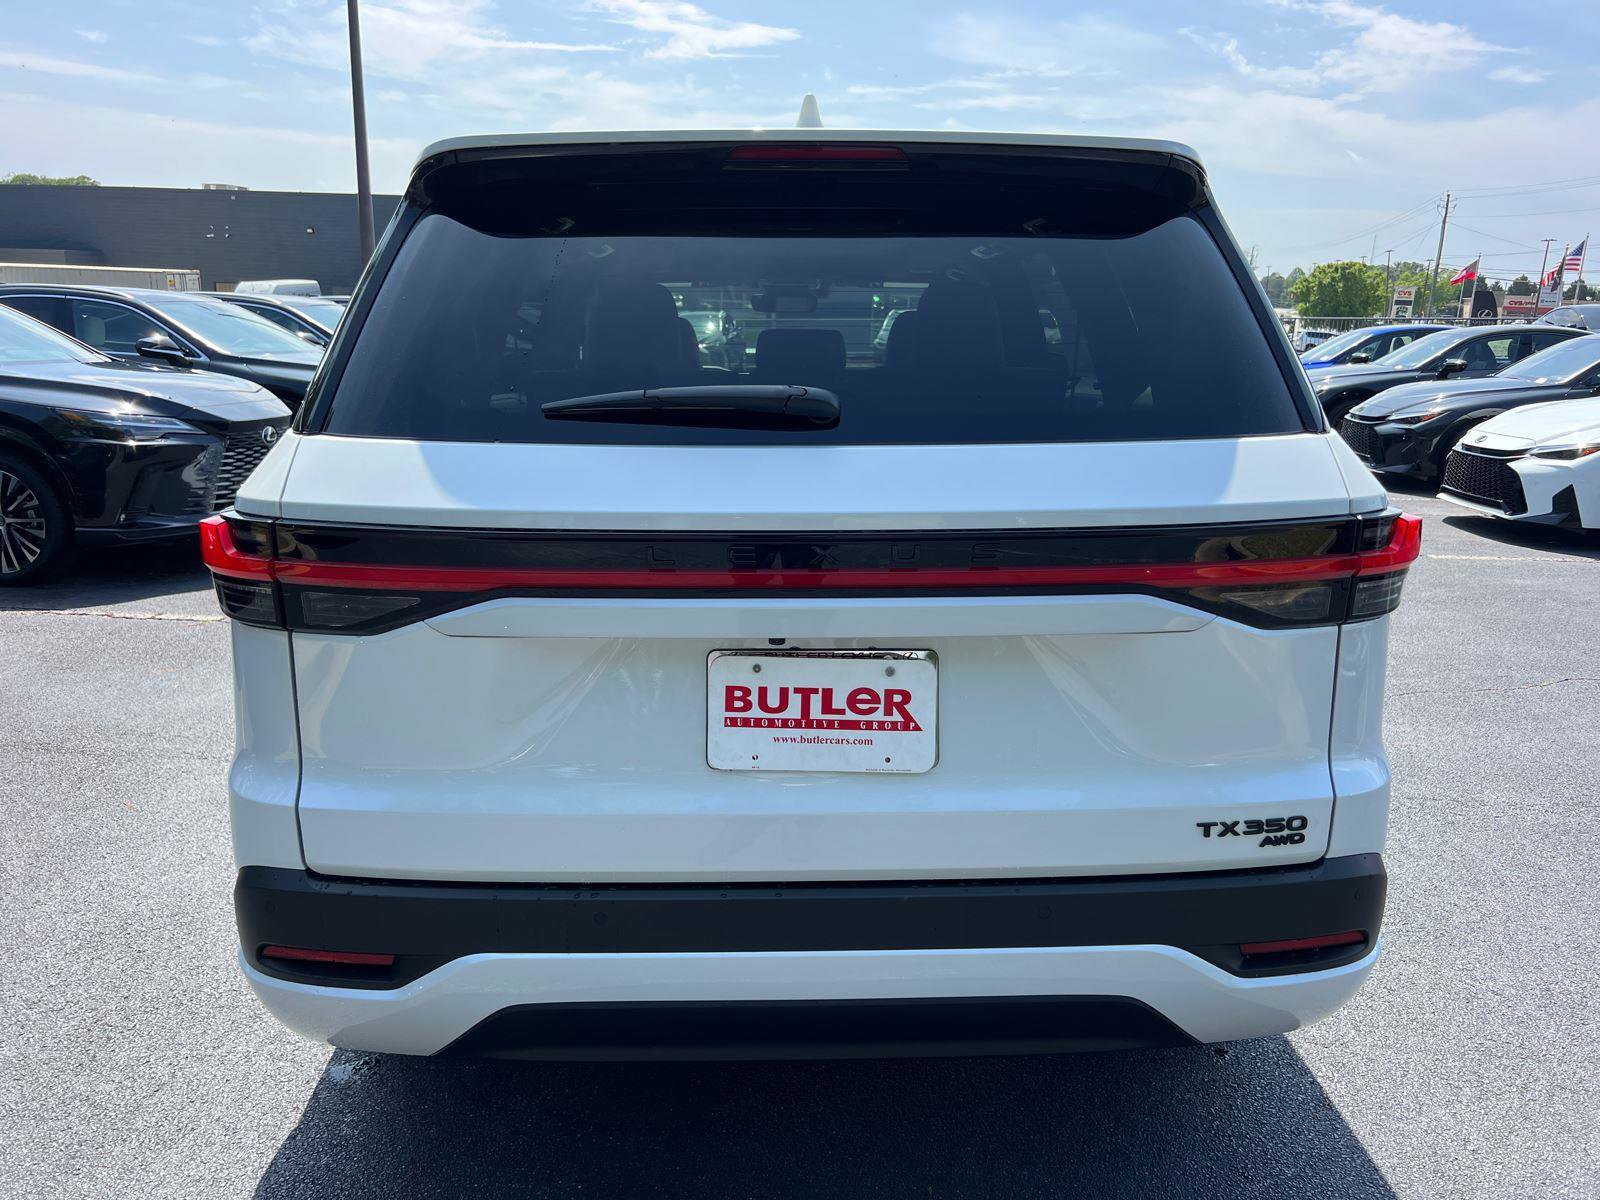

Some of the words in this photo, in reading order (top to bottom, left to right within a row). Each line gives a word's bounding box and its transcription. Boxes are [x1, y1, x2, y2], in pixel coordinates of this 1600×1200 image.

[648, 543, 1000, 567] LEXUS
[725, 717, 840, 729] AUTOMOTIVE
[860, 721, 917, 730] GROUP
[773, 735, 874, 746] www.butlercars.com
[1259, 832, 1306, 848] AWD
